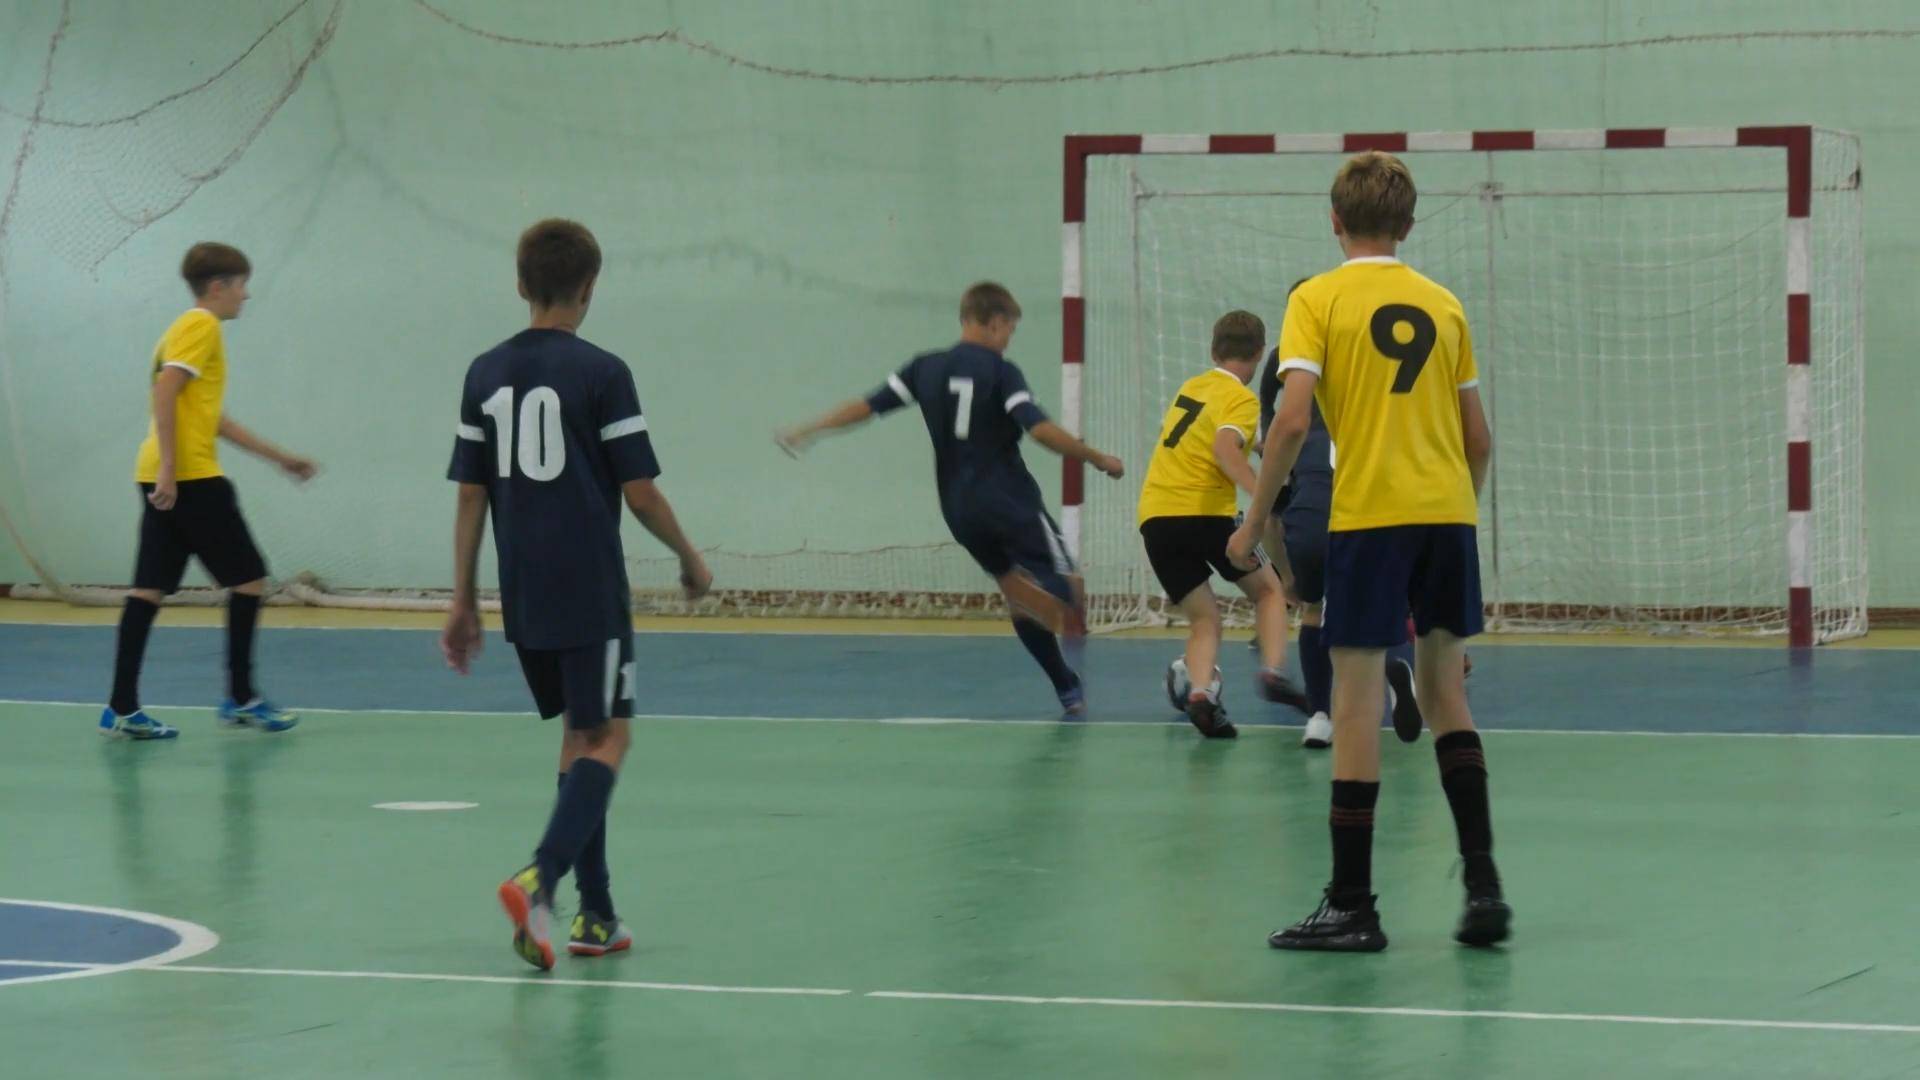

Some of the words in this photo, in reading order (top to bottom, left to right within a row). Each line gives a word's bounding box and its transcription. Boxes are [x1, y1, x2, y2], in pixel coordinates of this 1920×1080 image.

[1369, 303, 1438, 394] 9
[481, 386, 566, 482] 10
[1163, 394, 1206, 448] 7
